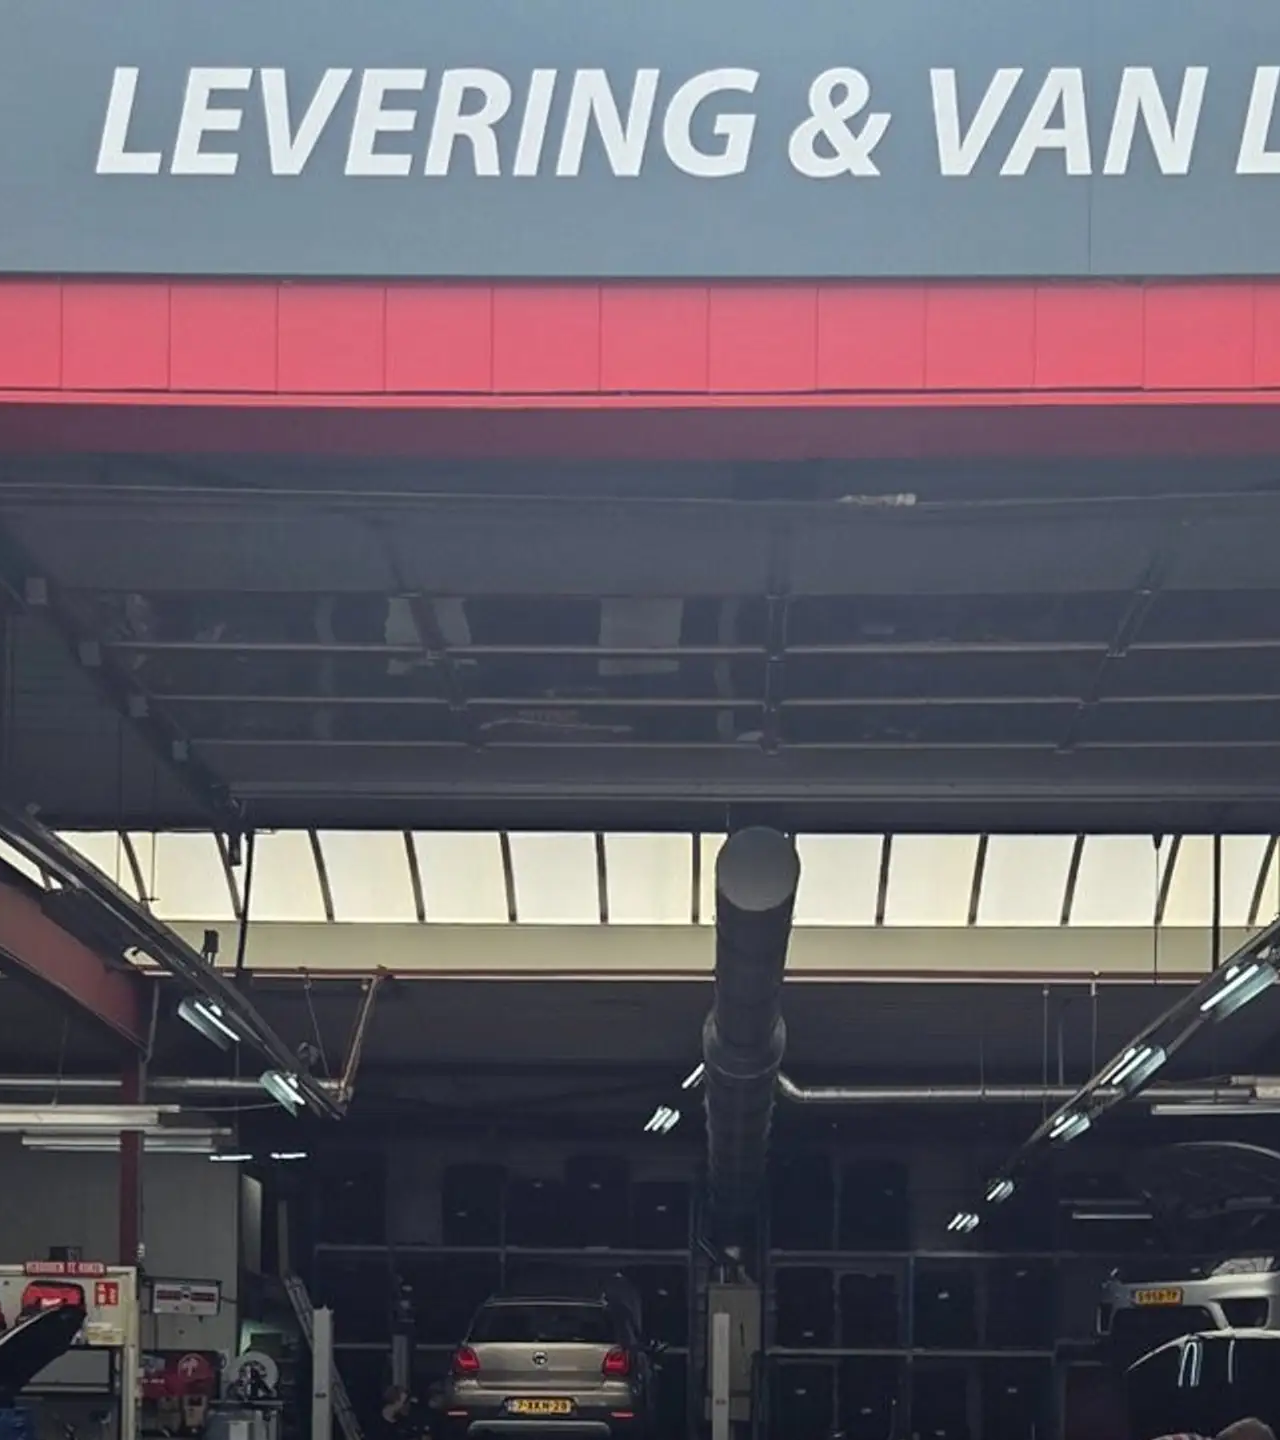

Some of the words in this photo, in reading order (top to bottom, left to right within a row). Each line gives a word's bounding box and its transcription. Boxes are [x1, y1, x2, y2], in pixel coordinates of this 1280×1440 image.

[95, 66, 760, 177] LEVERING
[788, 67, 892, 178] &
[929, 66, 1209, 176] VAN
